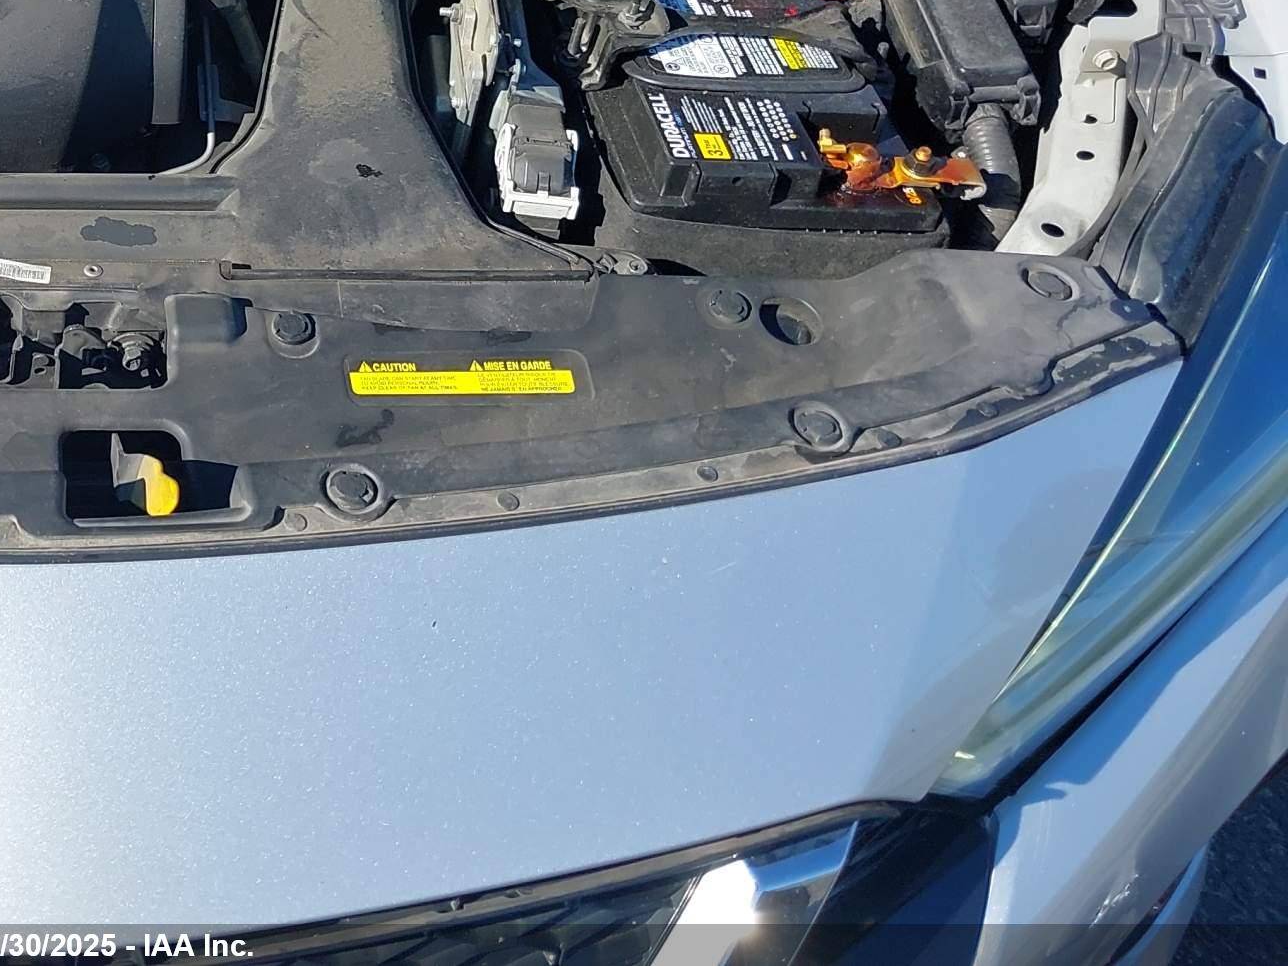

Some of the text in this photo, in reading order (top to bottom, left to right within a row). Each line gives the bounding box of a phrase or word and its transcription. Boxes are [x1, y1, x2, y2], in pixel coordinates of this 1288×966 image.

[648, 93, 691, 159] DURACELL
[372, 363, 417, 372] CAUTION
[483, 361, 552, 371] MISE EN GARDE
